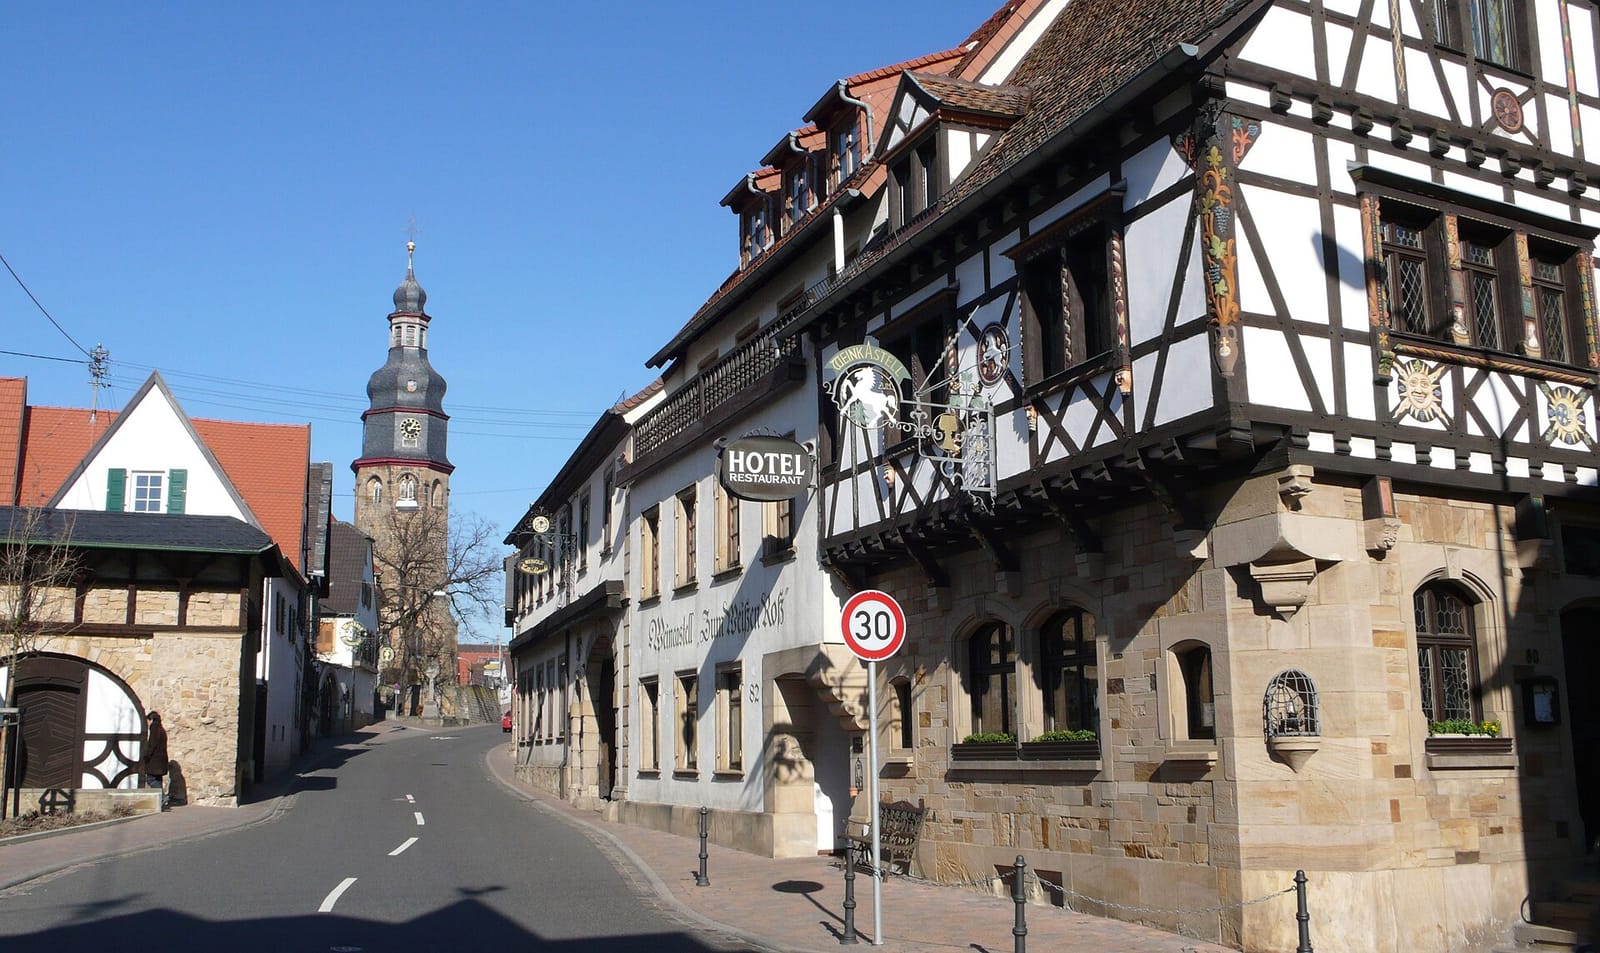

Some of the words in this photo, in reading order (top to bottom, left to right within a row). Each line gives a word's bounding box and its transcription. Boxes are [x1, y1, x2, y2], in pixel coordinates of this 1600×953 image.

[728, 450, 806, 476] HOTEL
[729, 473, 803, 485] RESTAURANT
[855, 610, 891, 641] 30
[749, 683, 760, 703] 82
